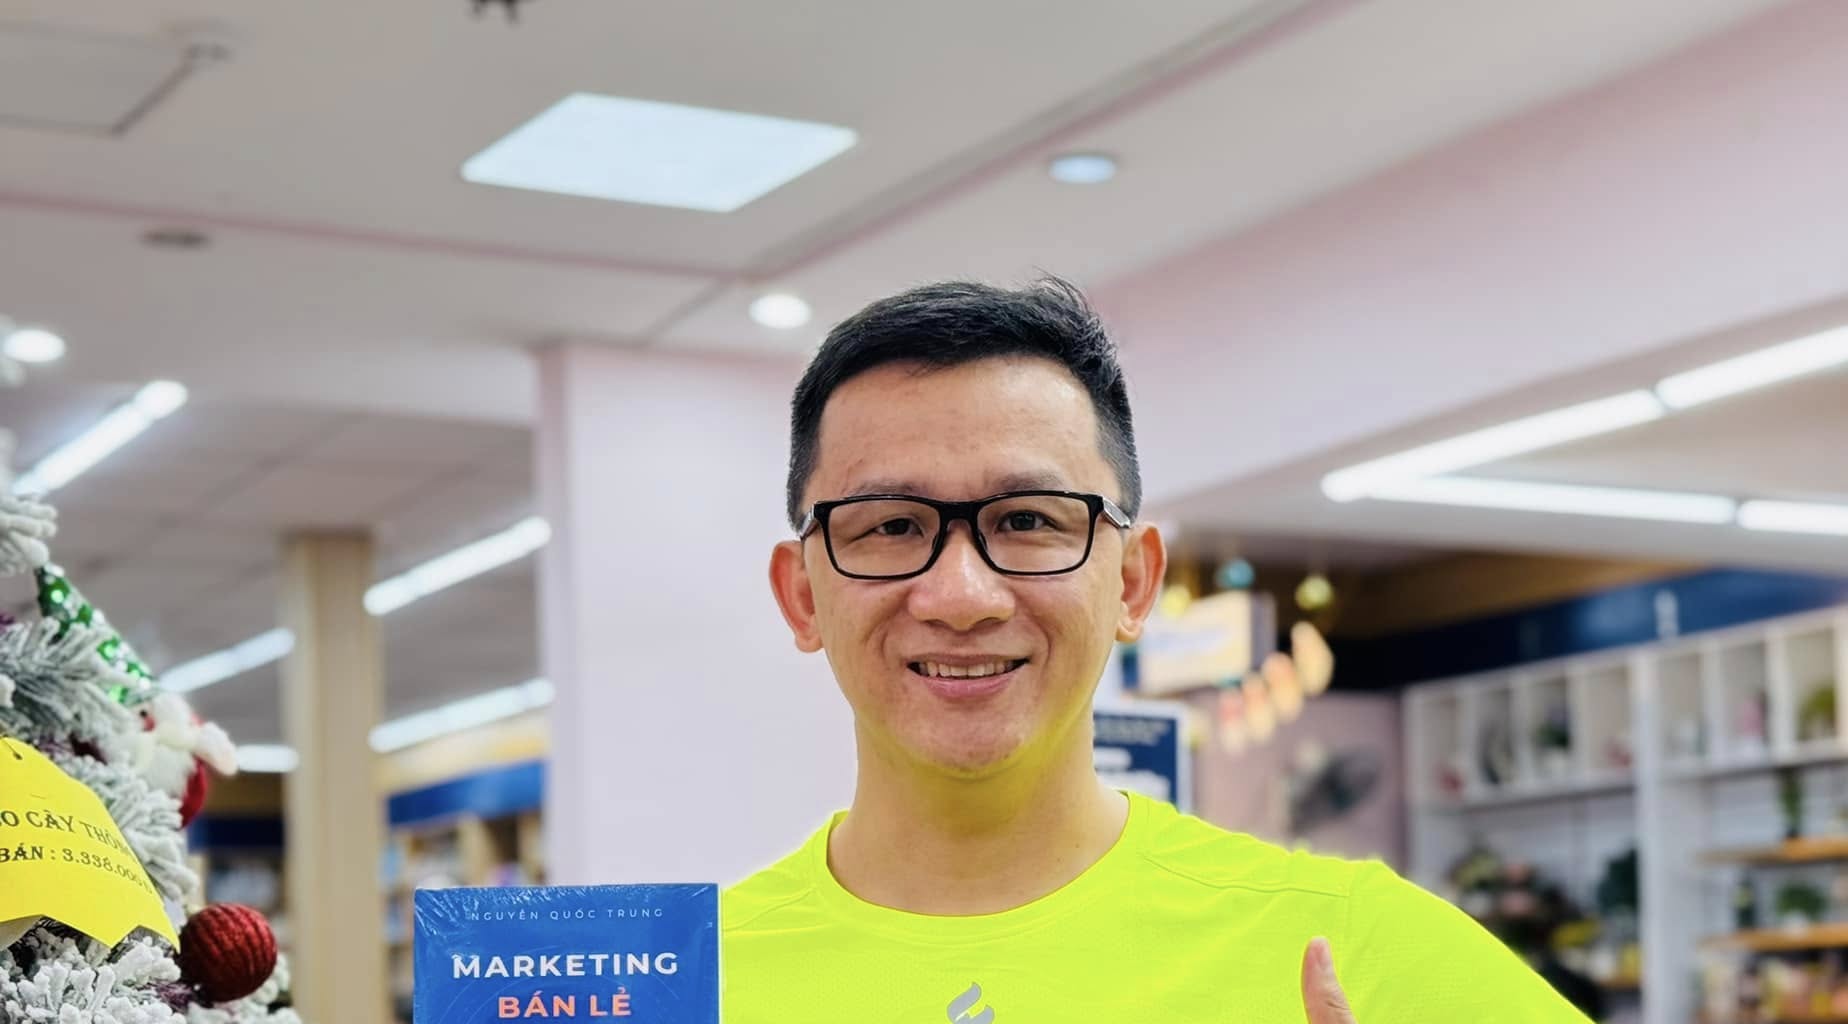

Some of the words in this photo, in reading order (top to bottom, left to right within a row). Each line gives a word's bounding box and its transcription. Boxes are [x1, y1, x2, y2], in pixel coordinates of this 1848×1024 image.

[550, 907, 597, 921] QUỐC
[607, 908, 664, 919] TRUNG
[452, 952, 679, 979] MARKETING
[498, 990, 576, 1019] BÁN
[589, 986, 632, 1017] LẺ
